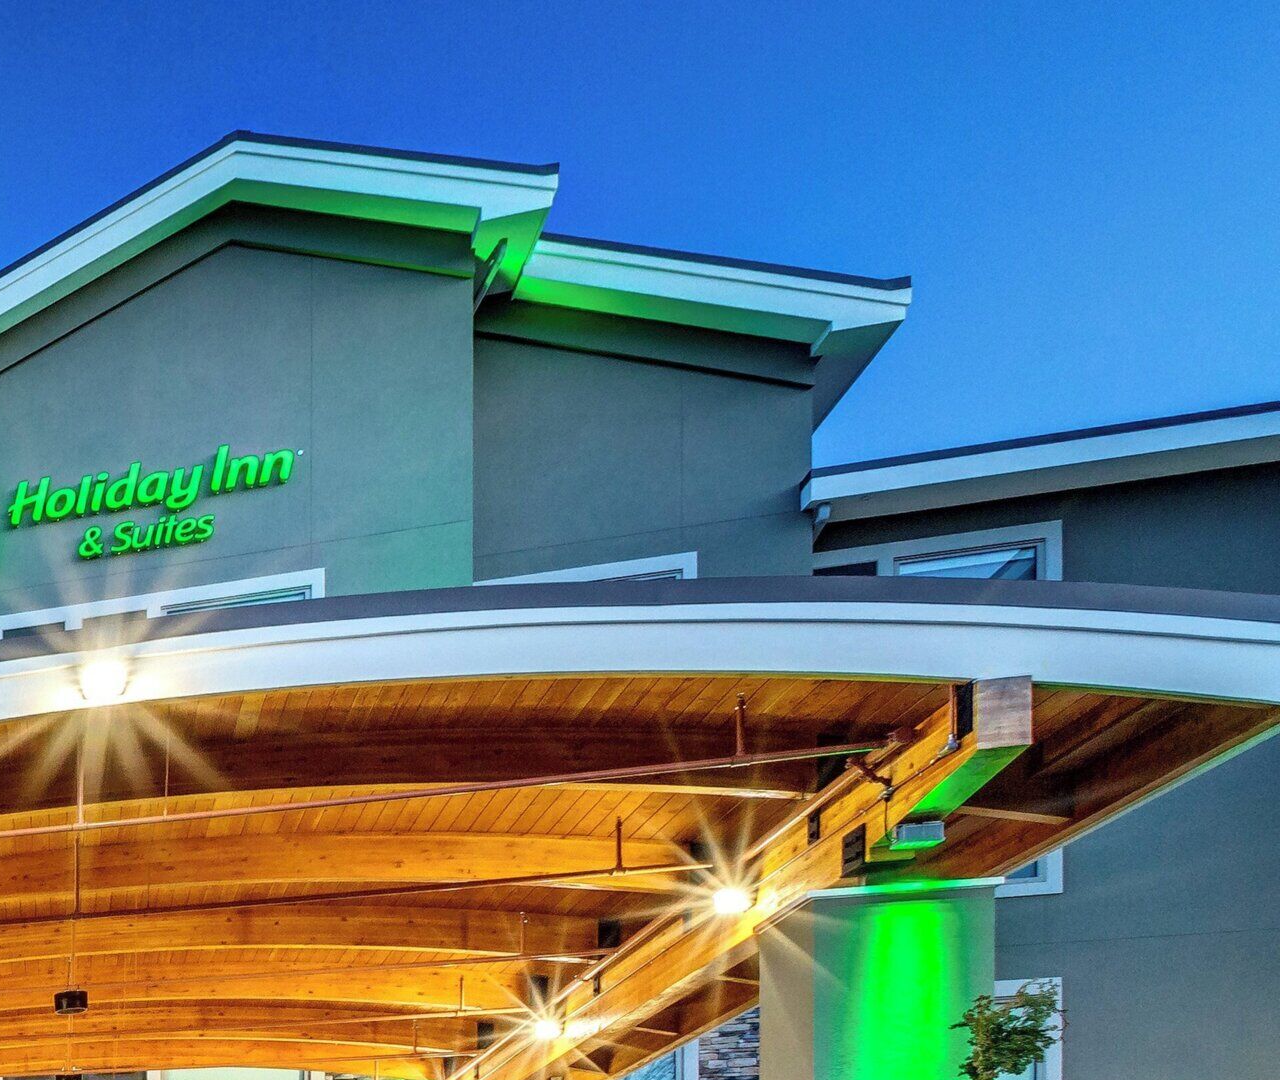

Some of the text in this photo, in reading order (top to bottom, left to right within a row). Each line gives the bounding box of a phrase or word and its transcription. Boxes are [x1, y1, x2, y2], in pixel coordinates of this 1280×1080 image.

[7, 443, 294, 529] Holiday Inn
[78, 513, 215, 559] & Suites
